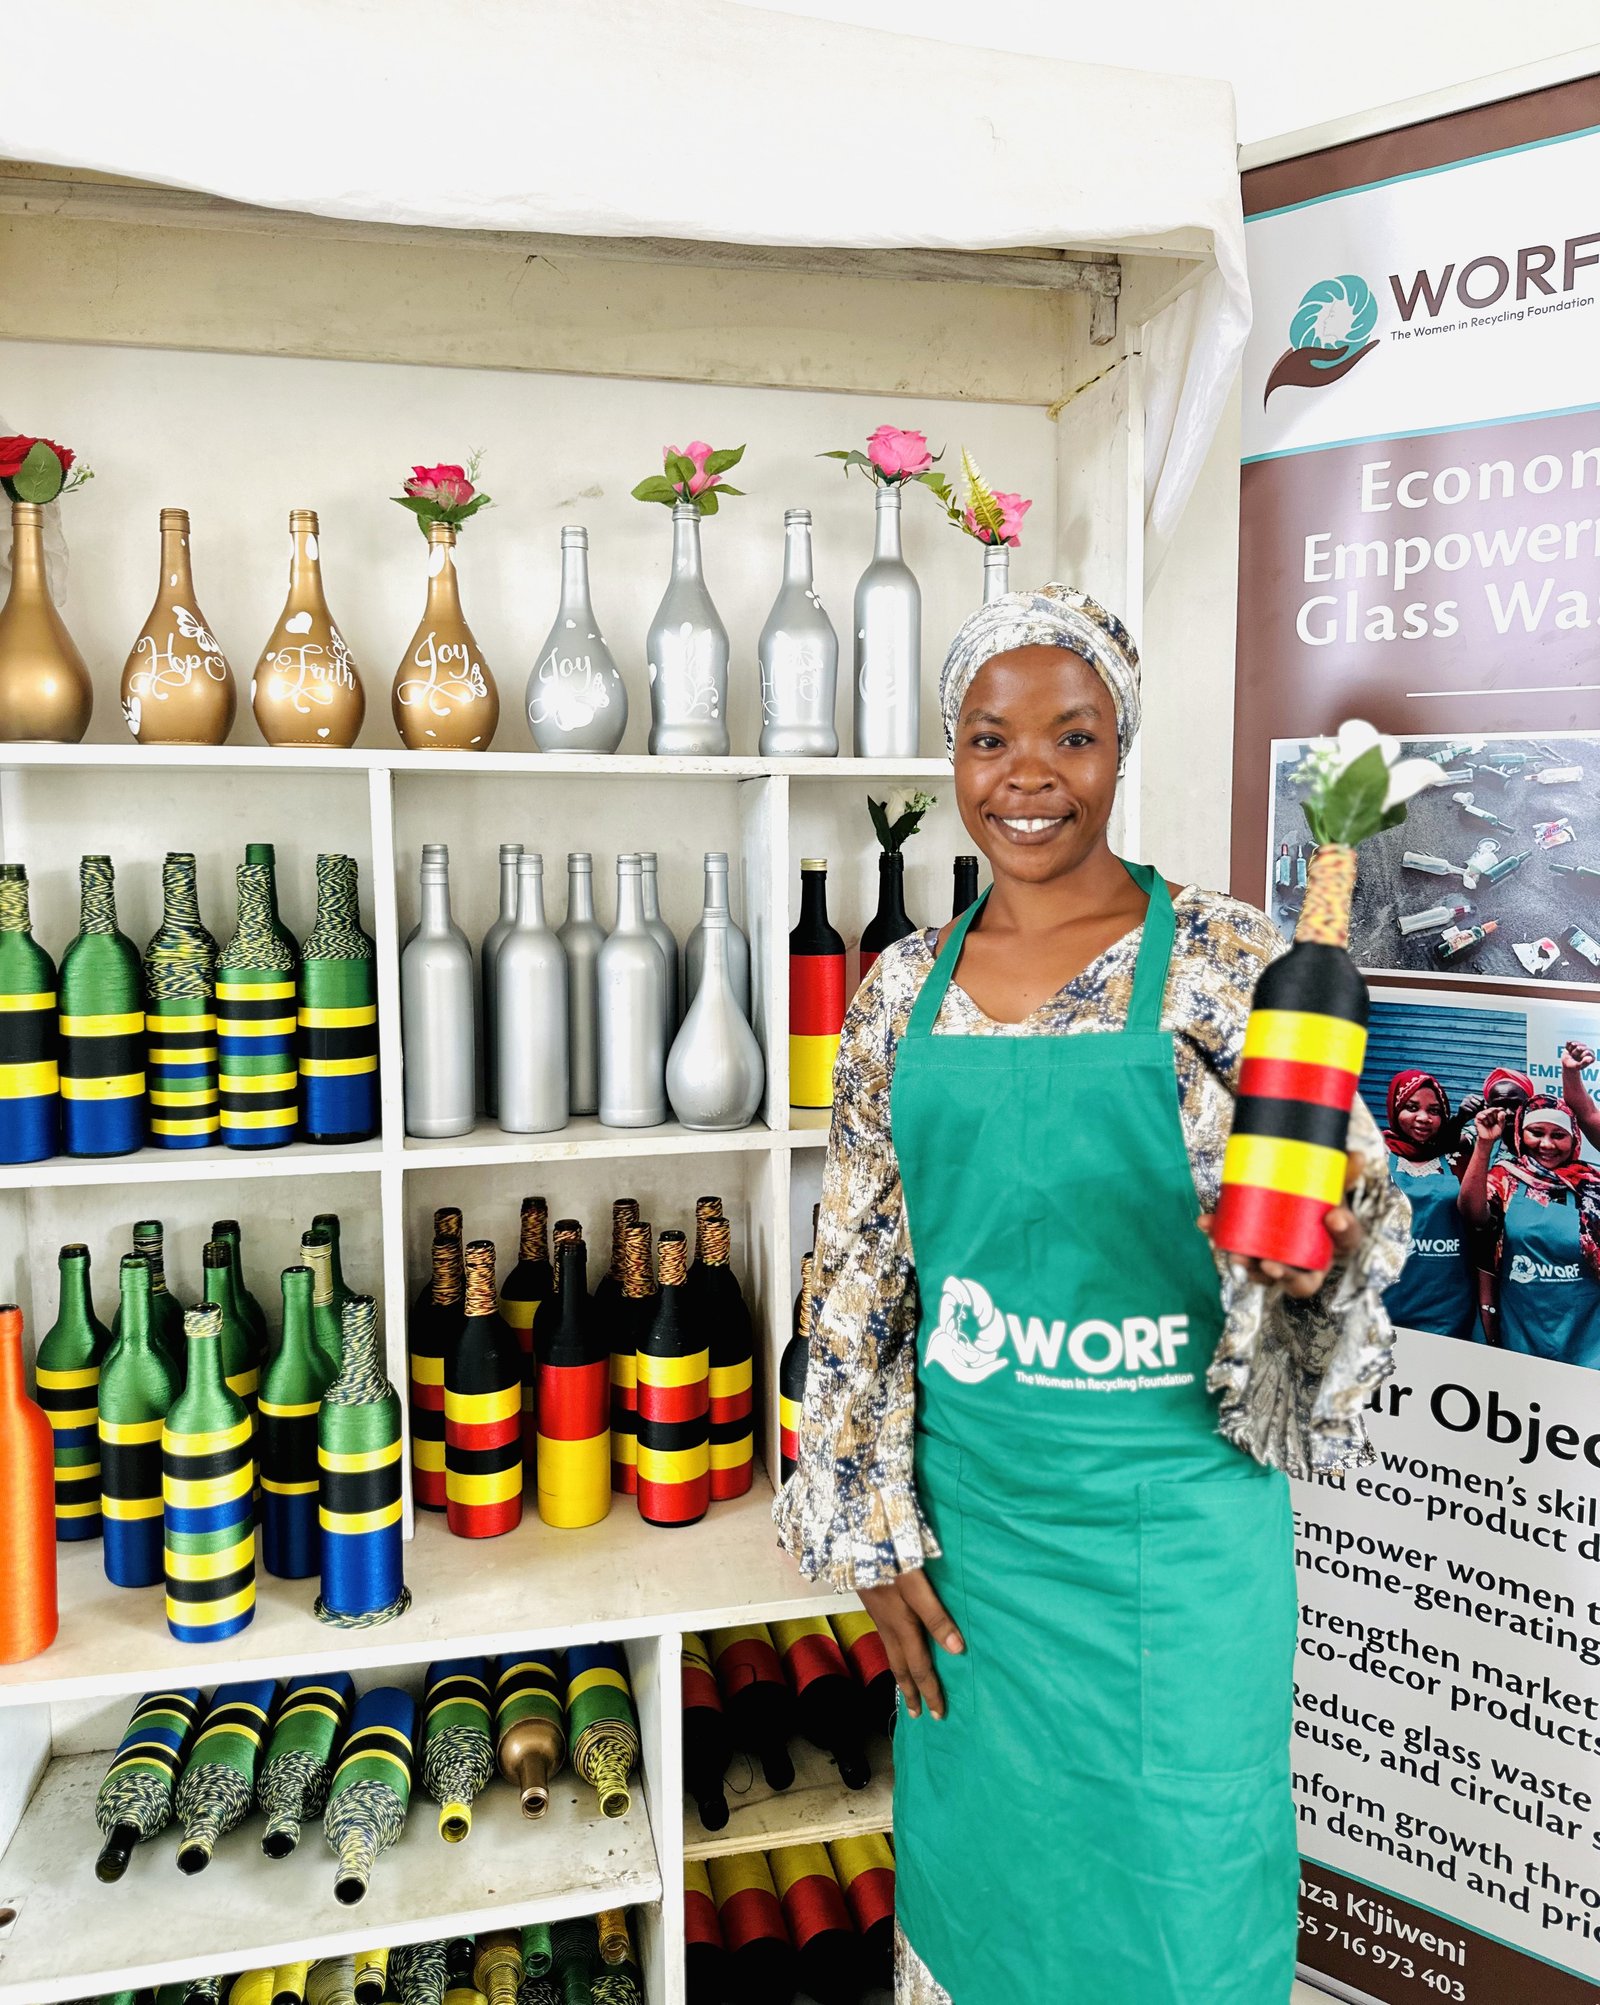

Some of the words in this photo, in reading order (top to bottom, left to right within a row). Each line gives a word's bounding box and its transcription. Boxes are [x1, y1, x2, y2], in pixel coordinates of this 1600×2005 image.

[1389, 232, 1600, 321] WORF
[1391, 331, 1411, 341] The
[1414, 322, 1456, 337] Women
[1458, 320, 1468, 330] in
[1471, 310, 1524, 327] Recycling
[1527, 297, 1595, 316] Foundation
[1304, 518, 1600, 591] Empower
[1296, 589, 1459, 646] Glass
[1484, 578, 1600, 634] Wa
[129, 632, 226, 700] Hope
[273, 644, 356, 713] Faith
[397, 632, 476, 716] Joy
[1416, 1239, 1460, 1253] WORF
[1536, 1263, 1580, 1278] WORF
[1006, 1314, 1189, 1374] WORF
[1014, 1371, 1034, 1385] The
[1034, 1374, 1073, 1390] Women
[1087, 1376, 1137, 1393] Recycling
[1138, 1373, 1195, 1388] Foundation
[1355, 1477, 1567, 1553] eco-product
[1381, 1451, 1527, 1507] women's
[1295, 1548, 1600, 1666] ncome-generating
[1446, 1559, 1575, 1618] women
[1296, 1636, 1442, 1696] co-decor
[1297, 1602, 1460, 1673] trengthen
[1472, 1660, 1599, 1721] market
[1292, 1718, 1370, 1763] euse,
[1380, 1749, 1441, 1787] and
[1450, 1776, 1583, 1840] circular
[1403, 1724, 1481, 1771] glass
[1490, 1758, 1592, 1813] waste
[1291, 1771, 1386, 1823] nform
[1394, 1812, 1513, 1875] growth
[1293, 1802, 1317, 1826] n
[1326, 1810, 1457, 1882] demand
[1466, 1872, 1530, 1914] and
[1325, 1923, 1367, 1956] 716
[1371, 1945, 1415, 1978] 973
[1420, 1968, 1466, 2002] 403
[1347, 1892, 1466, 1967] Kijiweni
